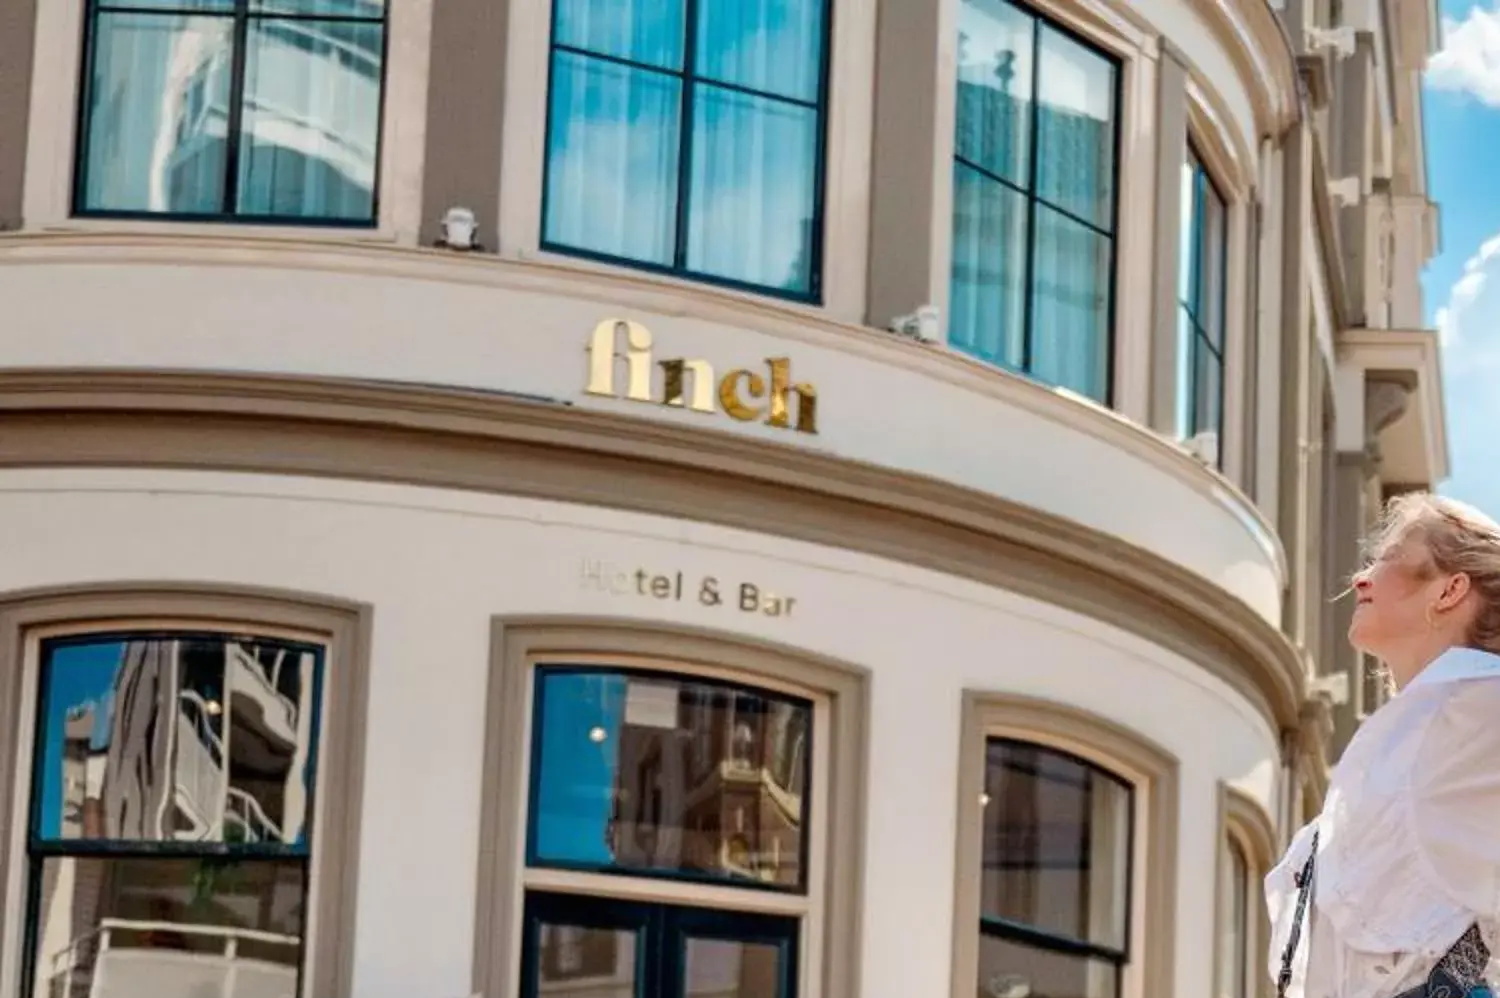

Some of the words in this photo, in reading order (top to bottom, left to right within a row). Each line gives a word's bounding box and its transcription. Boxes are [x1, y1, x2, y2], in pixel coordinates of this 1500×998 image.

[583, 317, 818, 434] finch
[698, 576, 722, 606] &
[738, 582, 796, 617] Bar
